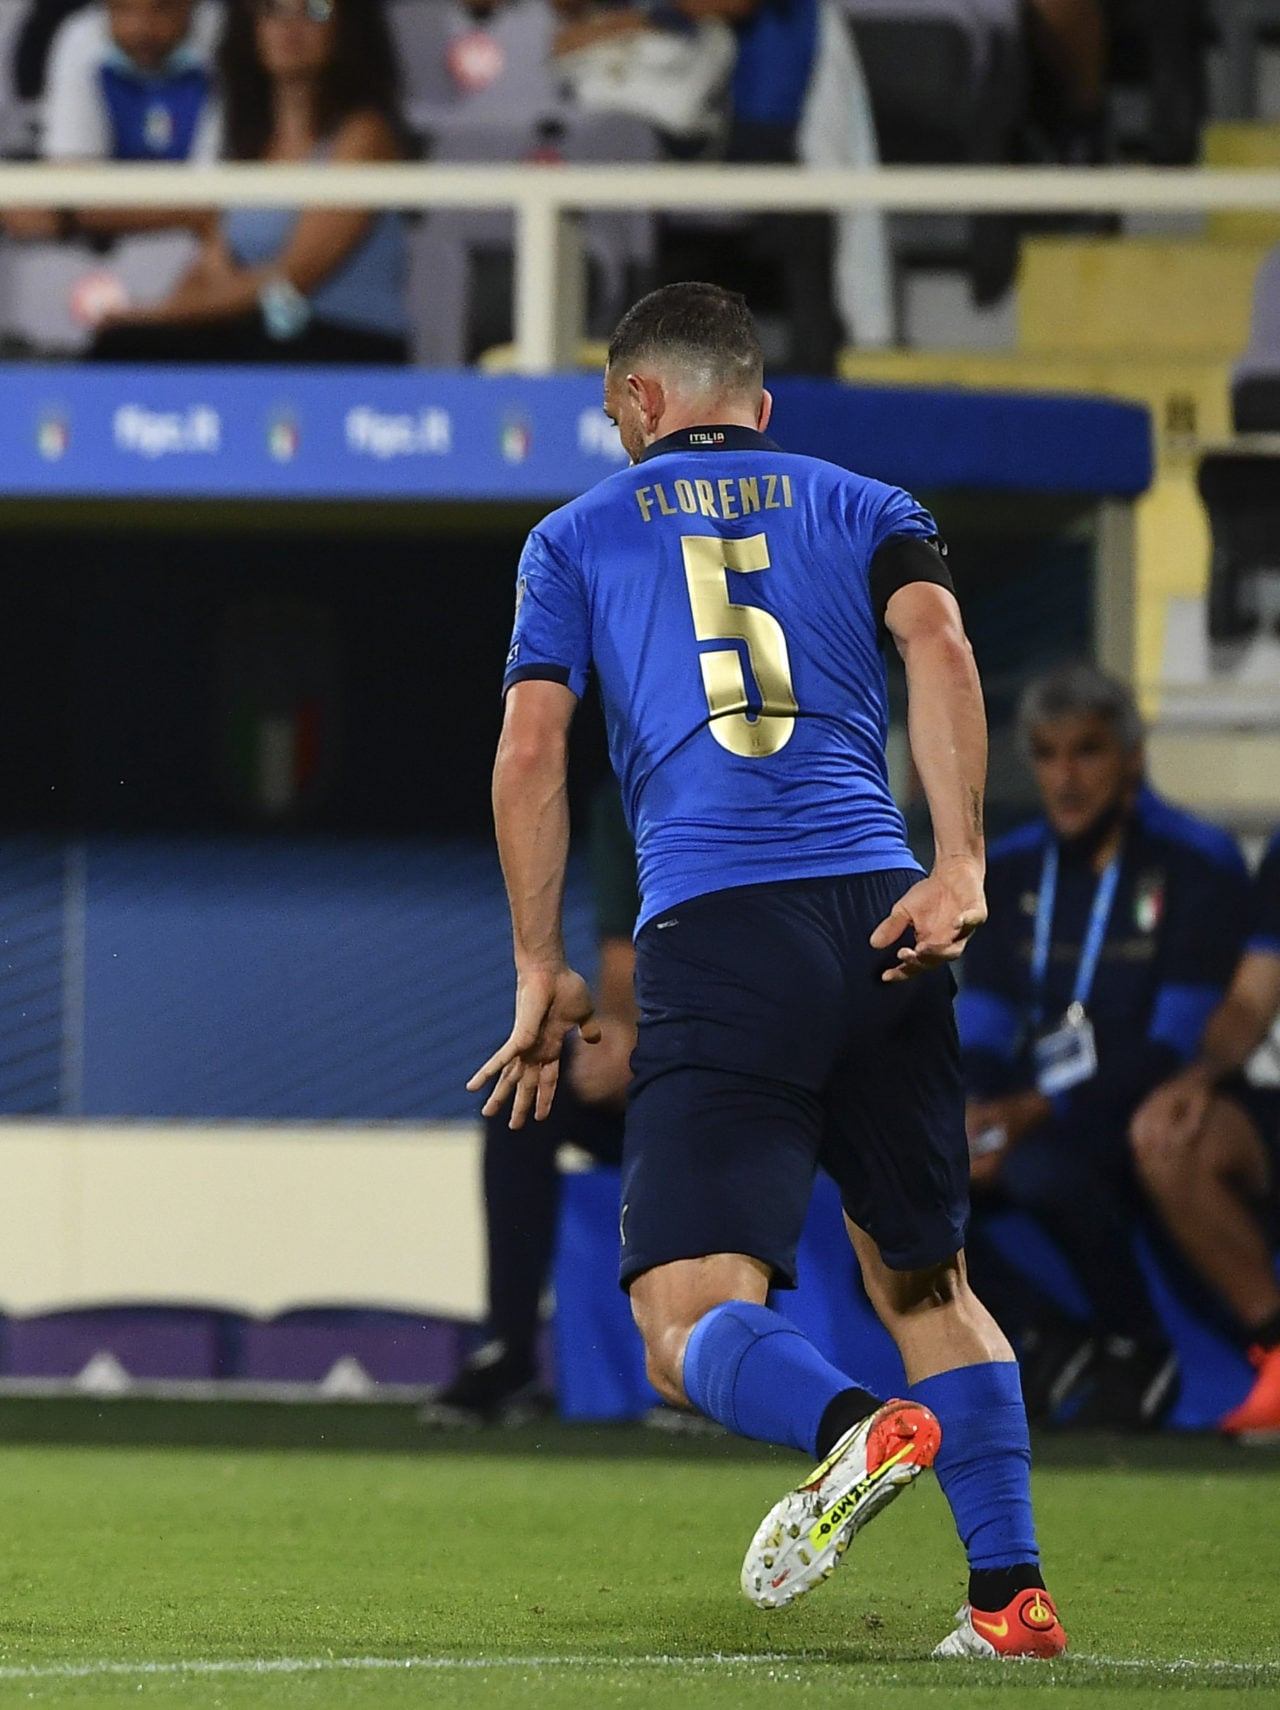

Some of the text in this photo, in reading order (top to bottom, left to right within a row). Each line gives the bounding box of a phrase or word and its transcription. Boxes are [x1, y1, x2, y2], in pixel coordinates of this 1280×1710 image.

[689, 432, 725, 442] ITALIA
[635, 475, 793, 522] FLORENZI
[681, 533, 800, 758] 5
